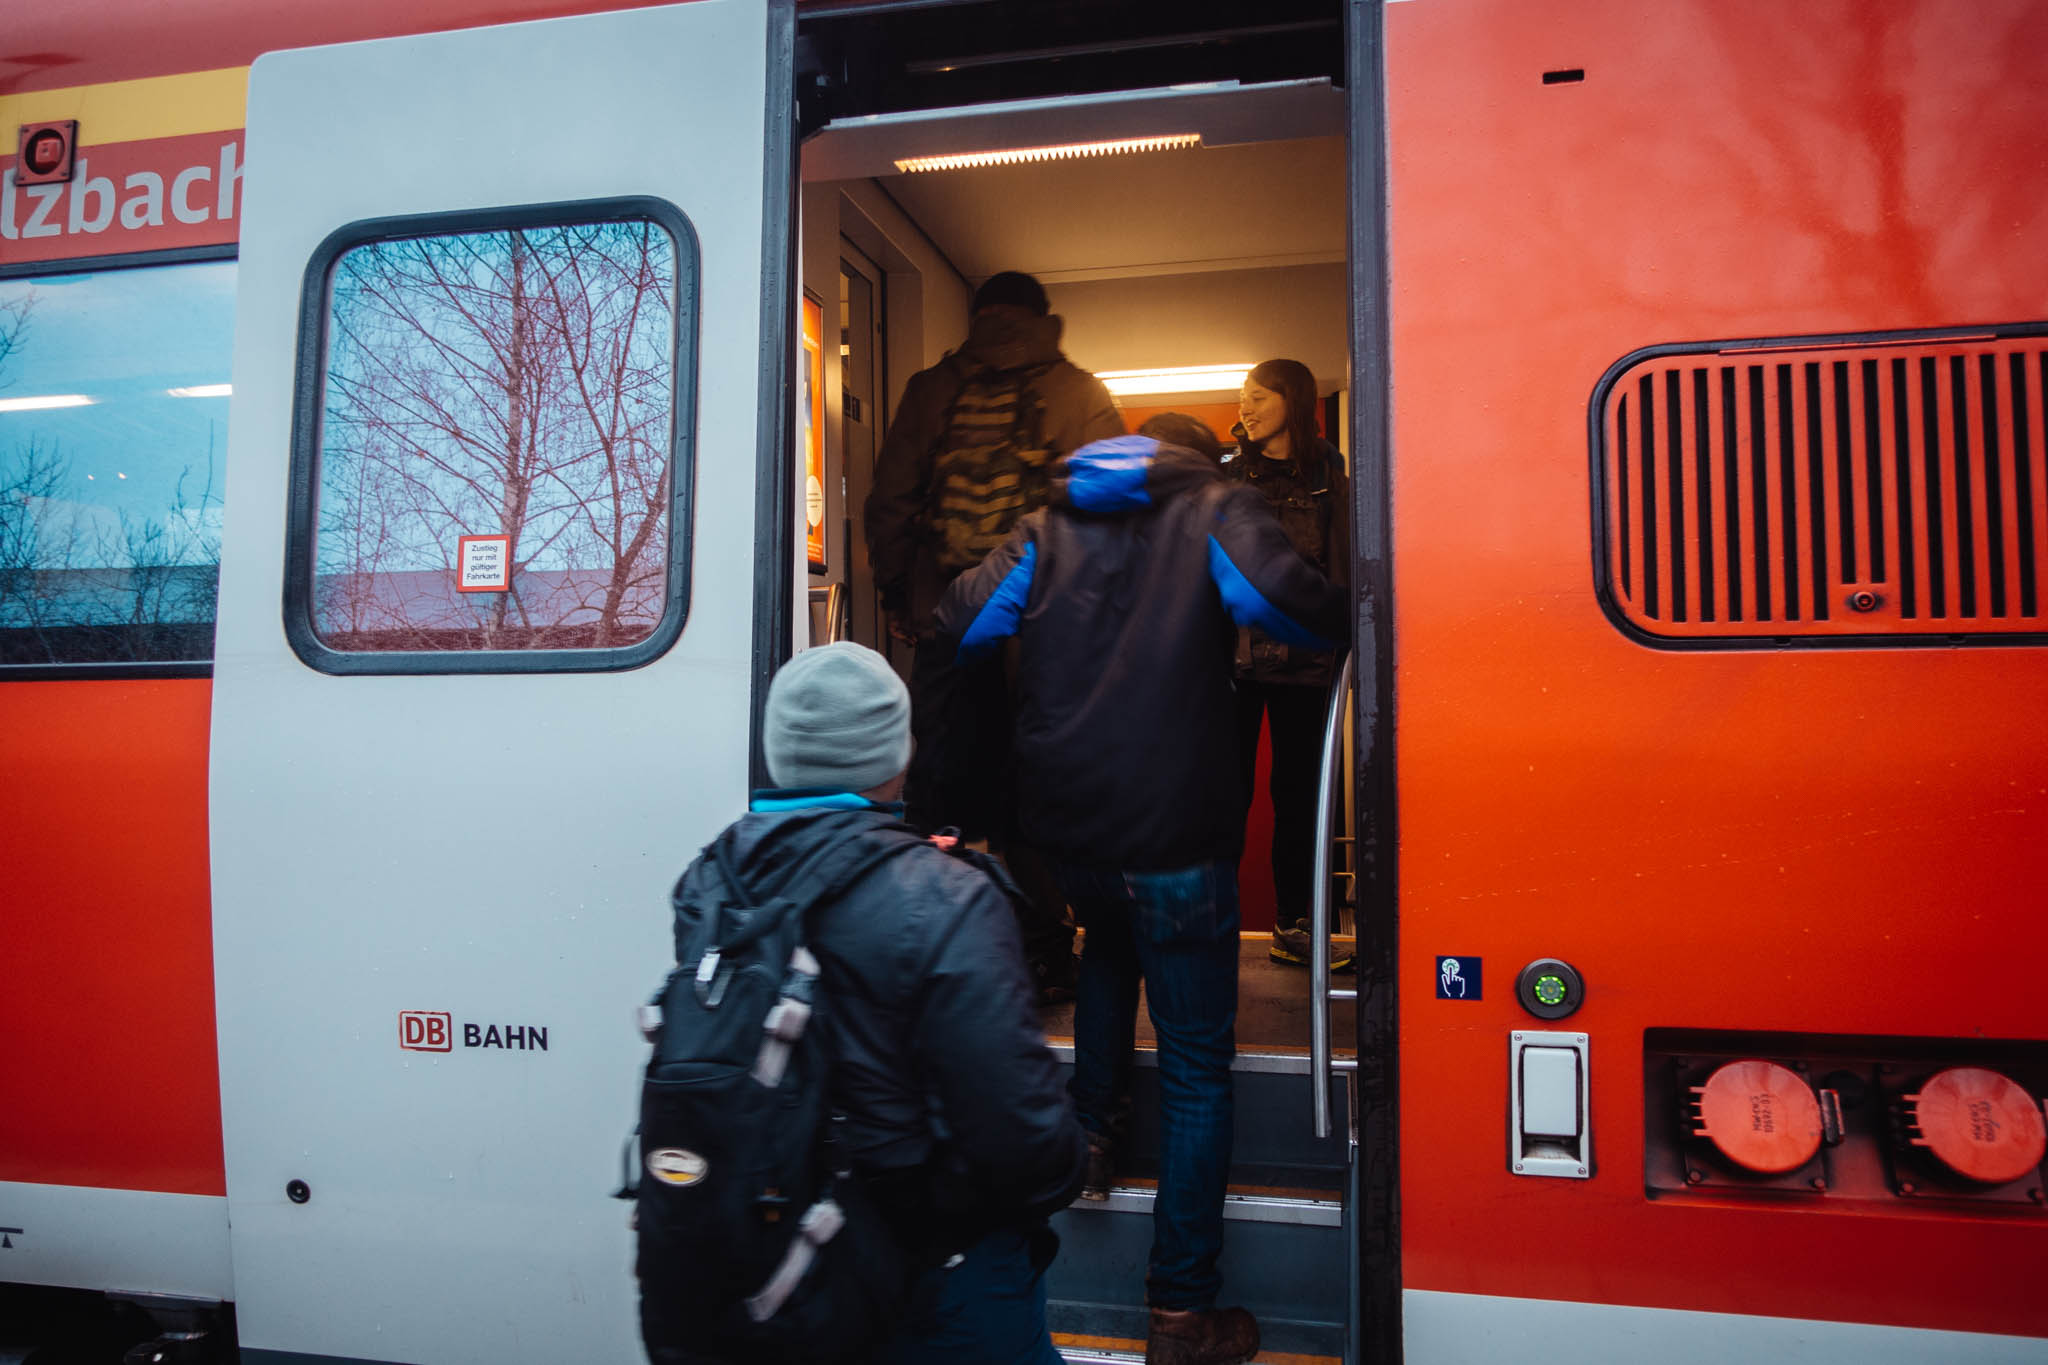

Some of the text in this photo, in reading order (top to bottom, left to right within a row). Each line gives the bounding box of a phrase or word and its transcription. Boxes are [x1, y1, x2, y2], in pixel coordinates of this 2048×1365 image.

[472, 544, 498, 552] Zustieg
[470, 564, 497, 572] gültiger
[405, 1016, 549, 1051] DB BAHN
